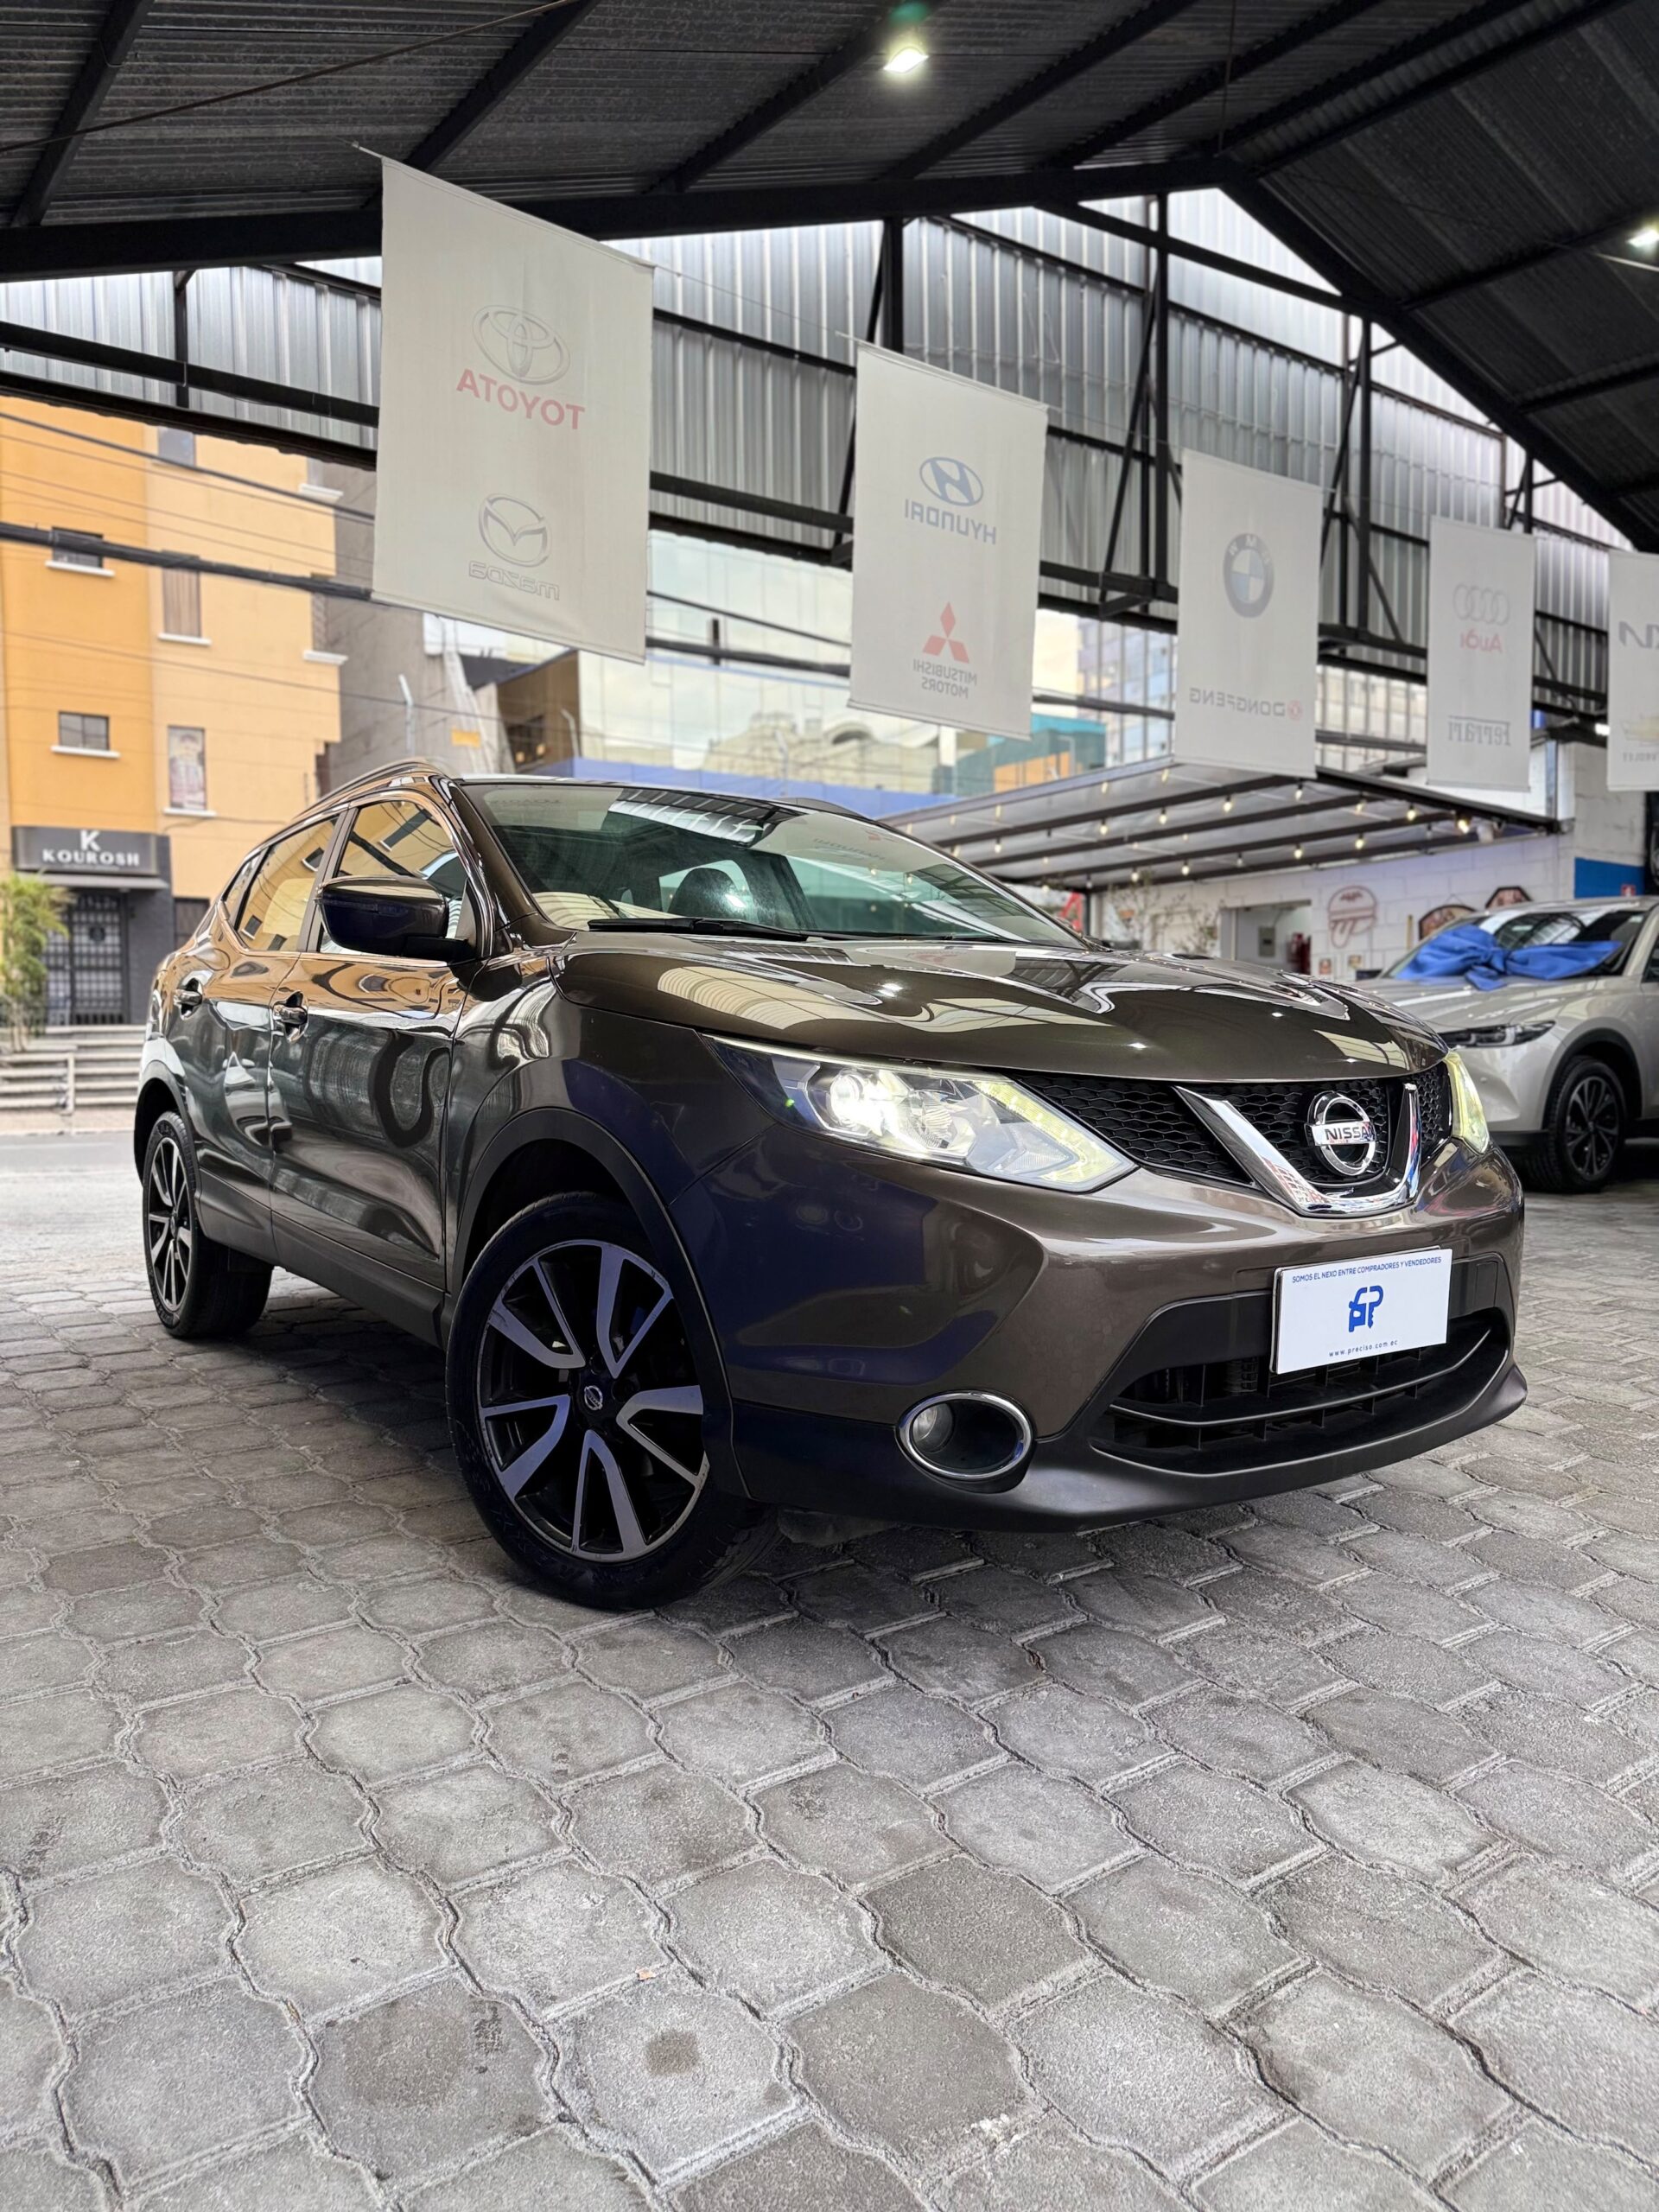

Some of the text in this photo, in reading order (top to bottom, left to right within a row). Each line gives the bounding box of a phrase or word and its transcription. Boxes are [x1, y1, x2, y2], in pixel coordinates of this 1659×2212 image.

[80, 830, 101, 852] K
[42, 849, 140, 867] KOUROSH
[1325, 1126, 1376, 1141] NISSAN
[1292, 1274, 1313, 1284] SOMOS
[1321, 1270, 1338, 1279] NEXO
[1338, 1267, 1357, 1276] ENTRE
[1357, 1262, 1400, 1274] COMPRADORES
[1405, 1256, 1442, 1268] VENDEDORES
[1328, 1339, 1398, 1357] www.preciso.com.ec
